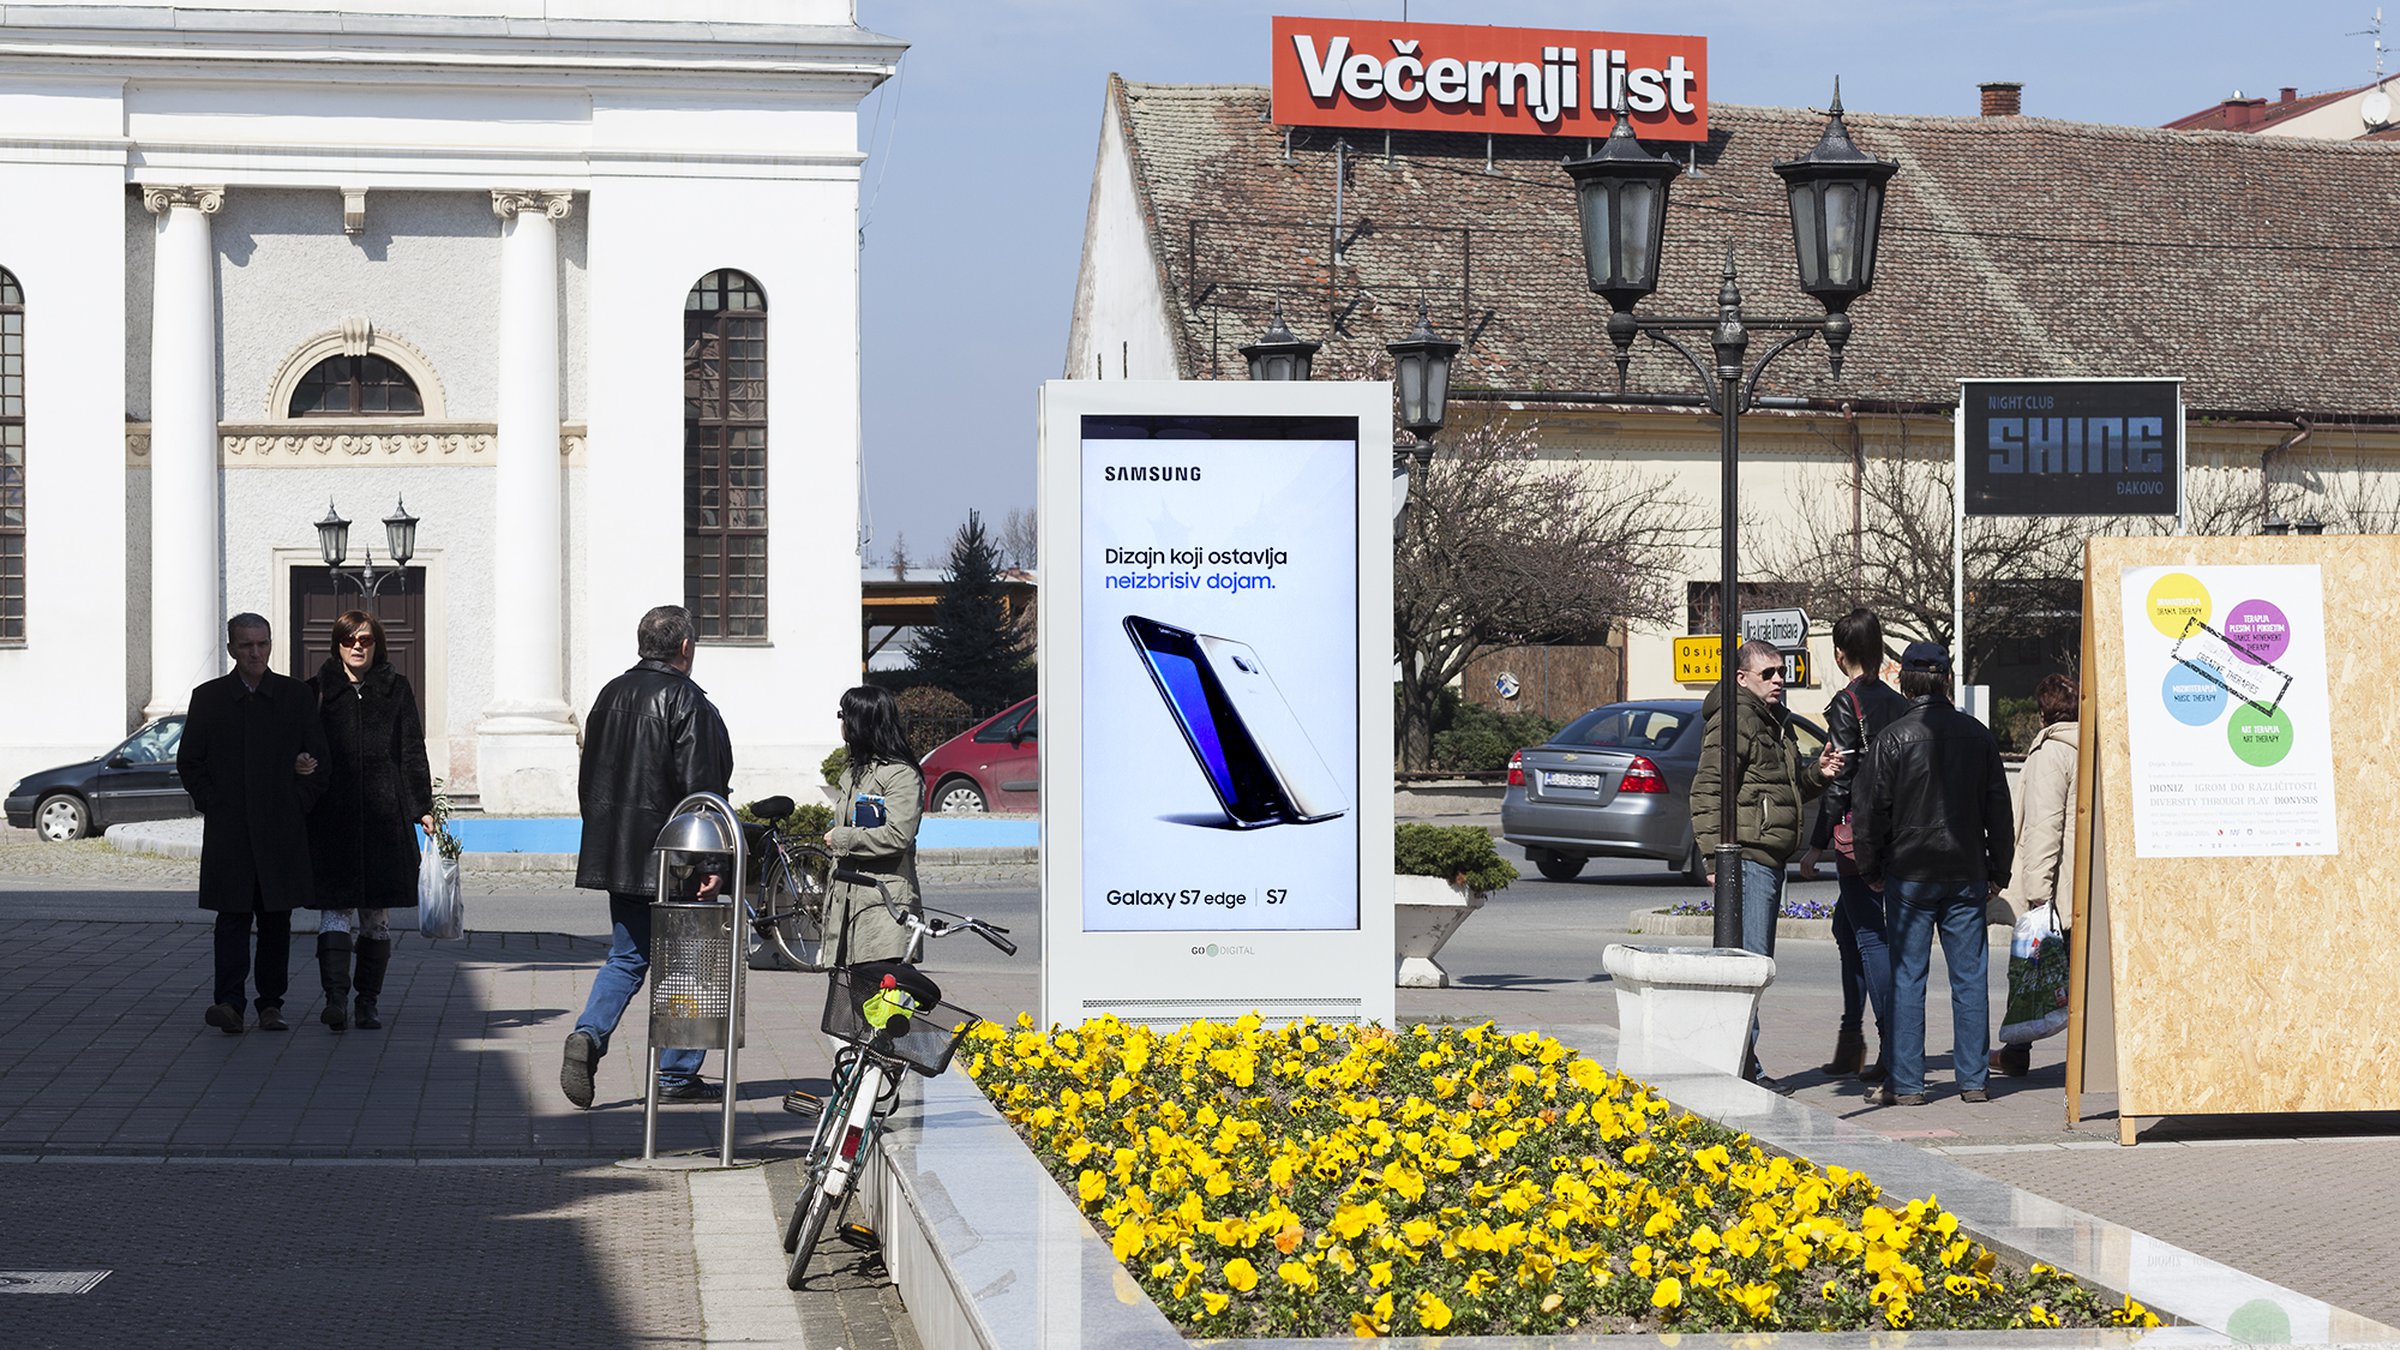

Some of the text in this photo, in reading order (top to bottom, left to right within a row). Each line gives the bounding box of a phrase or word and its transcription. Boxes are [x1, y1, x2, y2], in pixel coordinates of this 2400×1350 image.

[1292, 35, 1696, 123] Večernji list
[1988, 396, 2054, 410] NIGHT CLUB
[1988, 417, 2163, 473] SHINE
[1104, 466, 1201, 481] SAMSUNG
[2117, 481, 2164, 495] ĐAKOVO
[1105, 547, 1287, 569] Dizajn koji ostavlja
[1105, 571, 1276, 594] neizbrisiv dojam.
[1683, 646, 1722, 658] Osije
[2150, 784, 2184, 793] DIONIZ
[2195, 783, 2226, 792] IGROM
[2230, 783, 2245, 791] DO
[2150, 796, 2318, 806] DIVERSITY THROUGH PLAY DIONYSUS
[1106, 889, 1287, 909] Galaxy S7 edge S7
[1191, 946, 1255, 955] GO DIGITAL
